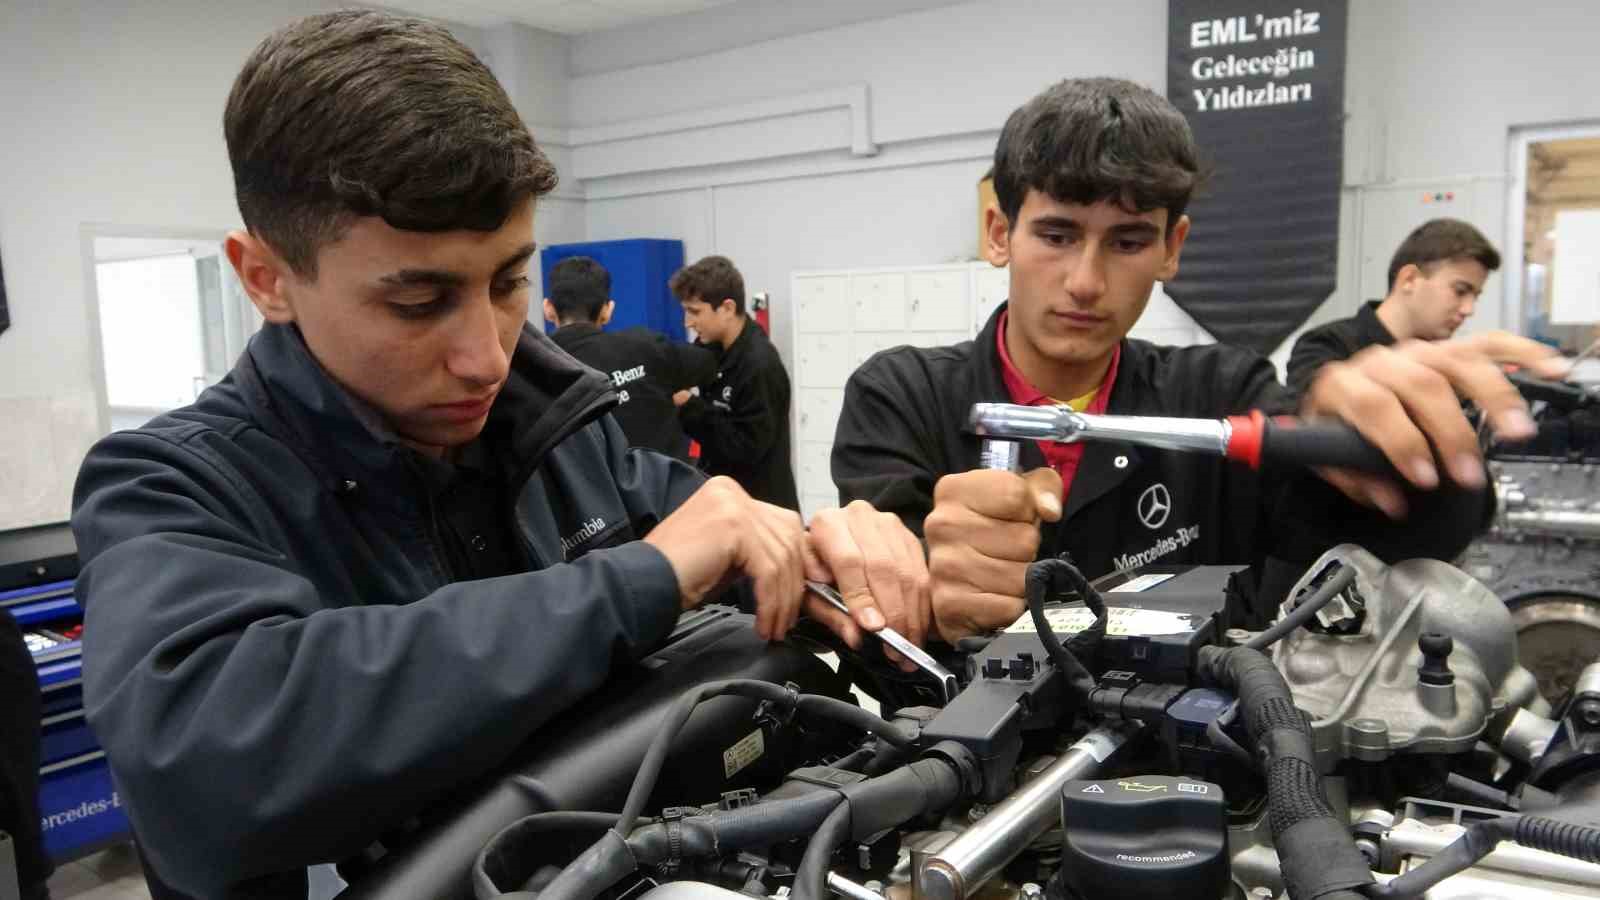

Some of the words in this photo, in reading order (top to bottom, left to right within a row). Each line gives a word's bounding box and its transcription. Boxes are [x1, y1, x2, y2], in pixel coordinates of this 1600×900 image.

[1190, 8, 1321, 48] EML'miz
[1191, 46, 1315, 80] Geleceğin
[1192, 82, 1313, 111] Yıldızları
[609, 365, 646, 387] -Benz
[1116, 850, 1196, 864] recommended
